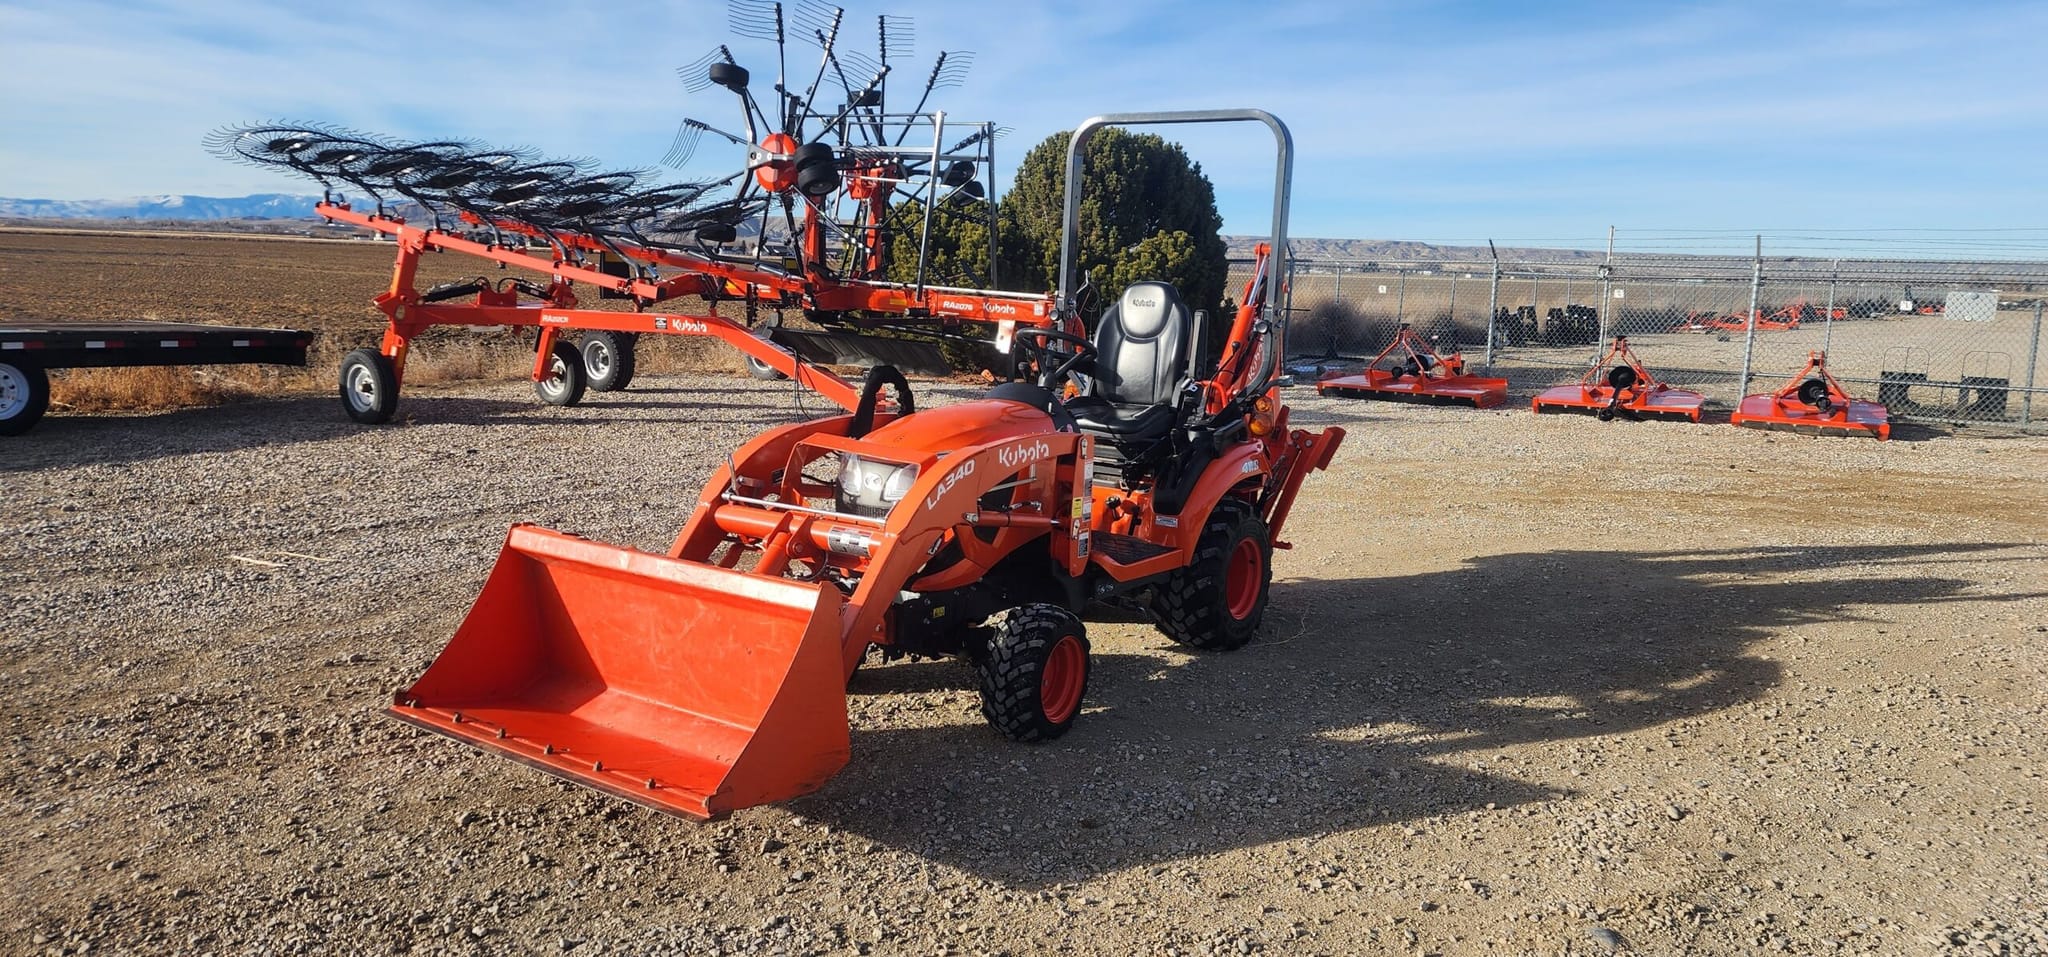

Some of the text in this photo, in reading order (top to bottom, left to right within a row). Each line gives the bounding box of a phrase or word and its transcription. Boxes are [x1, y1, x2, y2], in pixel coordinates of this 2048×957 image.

[982, 302, 1016, 315] Kubota
[672, 319, 708, 333] Kubota
[999, 440, 1049, 467] Kubota
[926, 459, 976, 511] LA340
